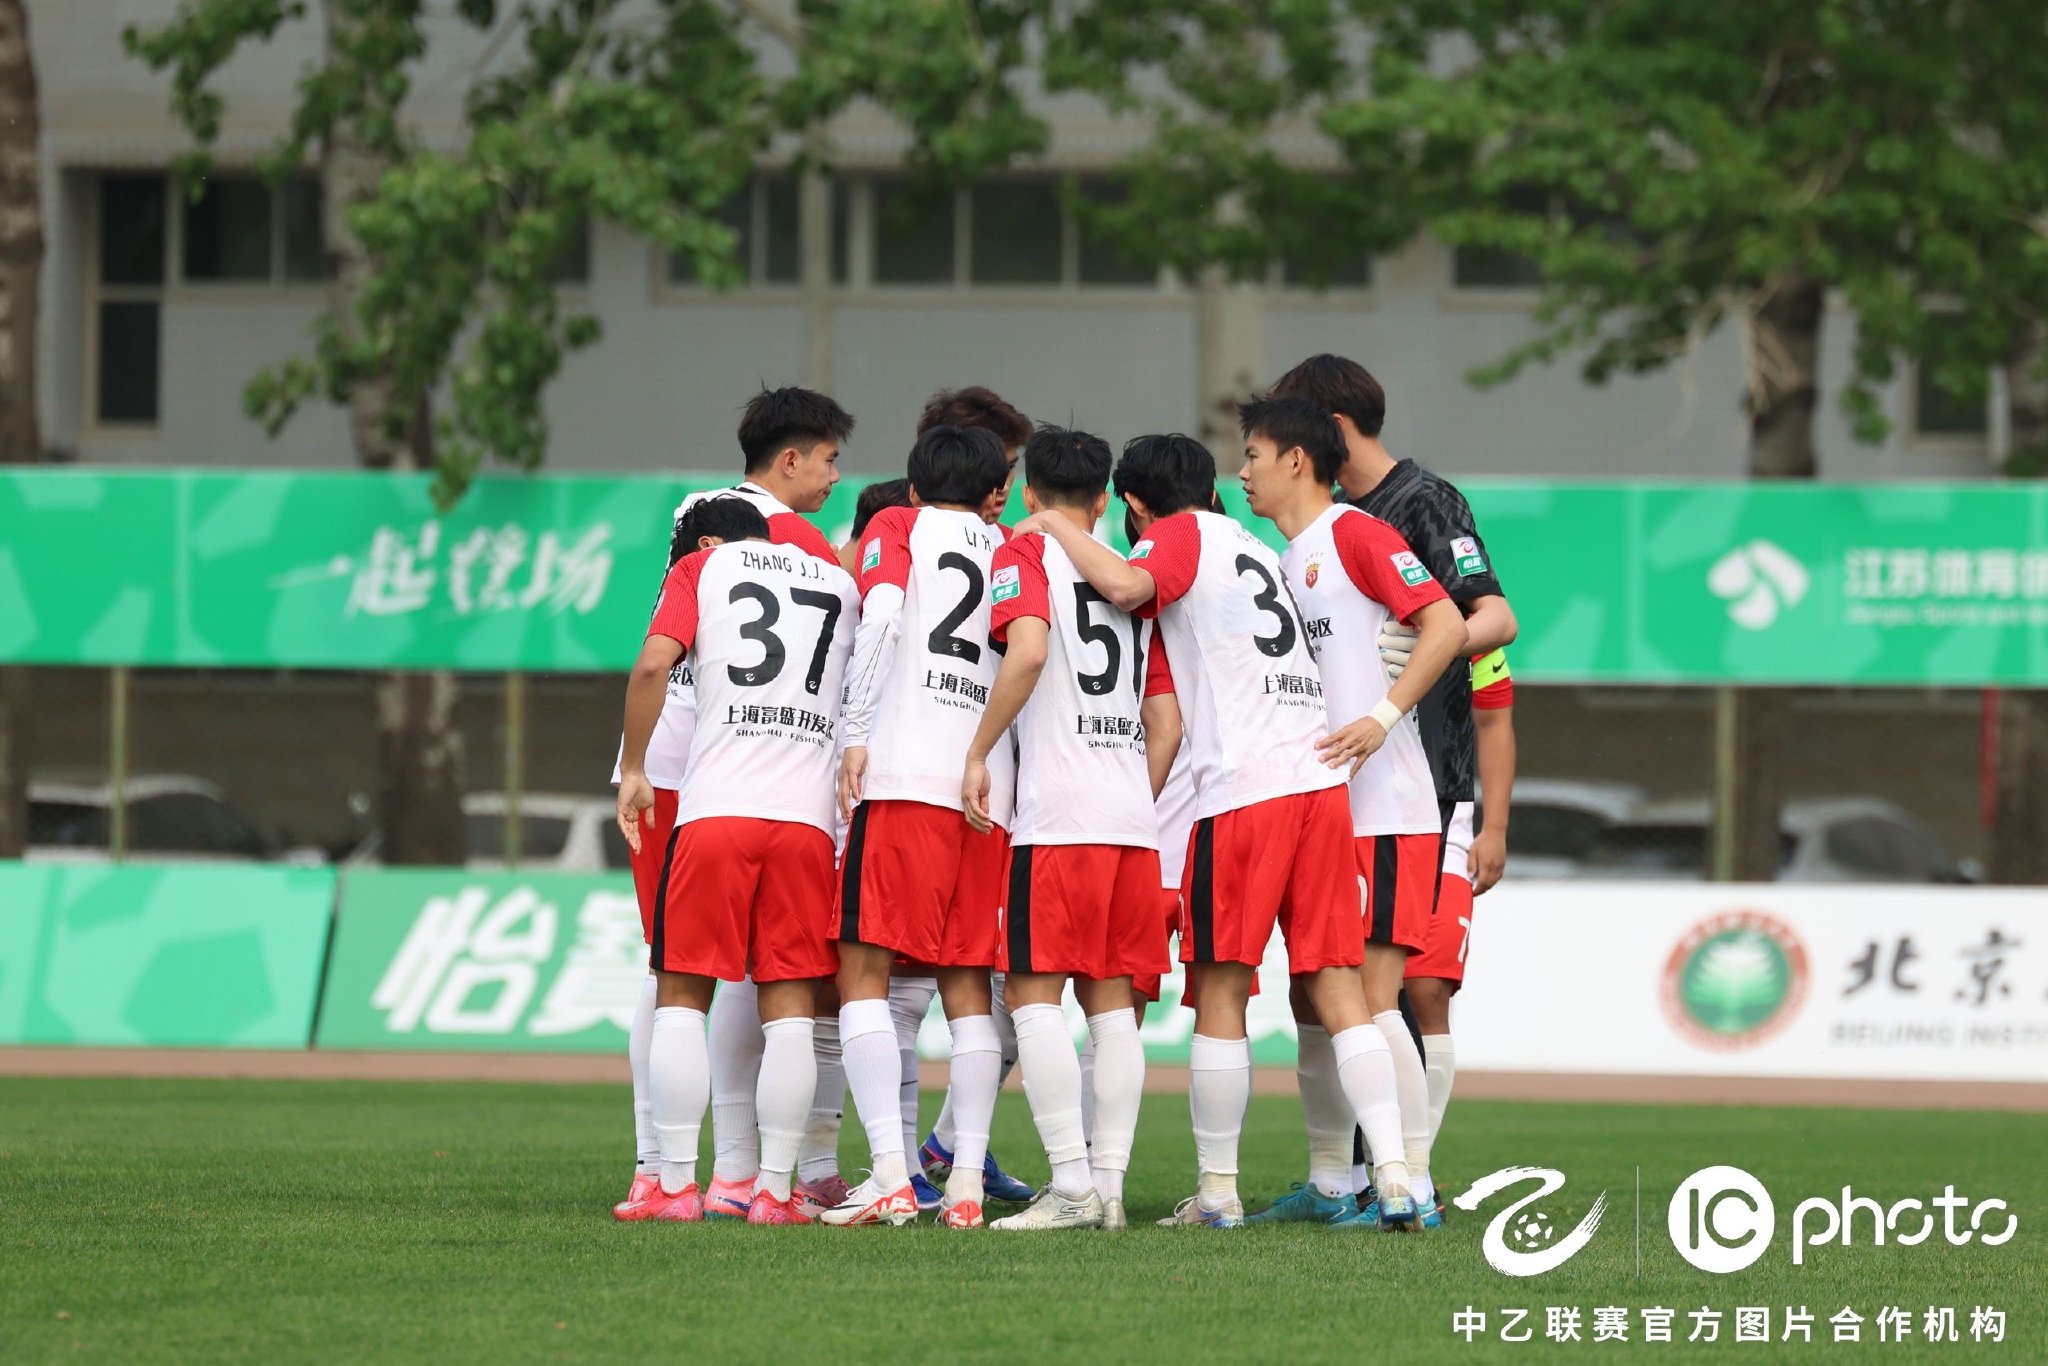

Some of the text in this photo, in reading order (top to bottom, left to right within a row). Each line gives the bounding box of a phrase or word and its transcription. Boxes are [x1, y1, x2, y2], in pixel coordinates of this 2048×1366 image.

[740, 551, 792, 573] ZHANG
[727, 581, 842, 696] 37
[1073, 582, 1144, 705] 5
[1842, 931, 2048, 1005] 北京
